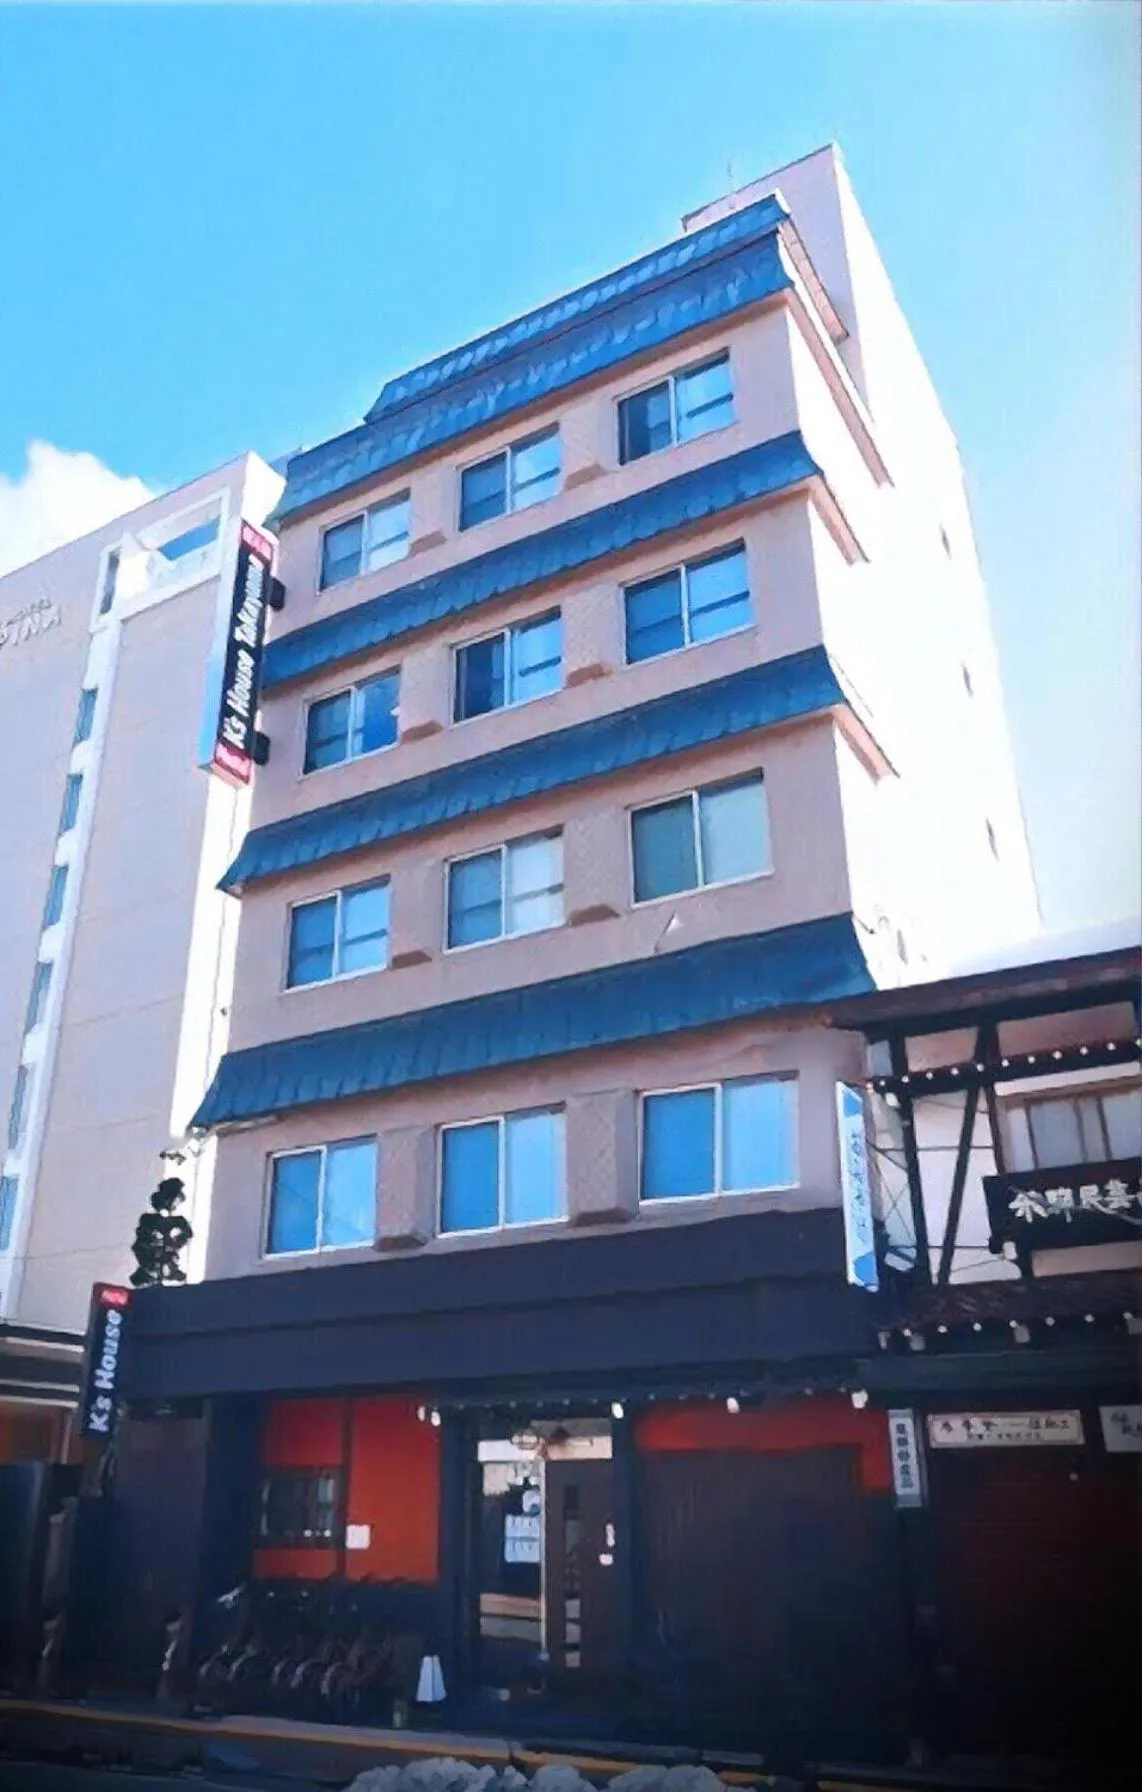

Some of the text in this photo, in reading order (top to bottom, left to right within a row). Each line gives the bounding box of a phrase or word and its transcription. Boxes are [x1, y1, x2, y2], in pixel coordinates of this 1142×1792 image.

[227, 650, 255, 717] House
[222, 716, 247, 749] K's
[94, 1308, 123, 1389] House
[88, 1395, 112, 1433] K's
